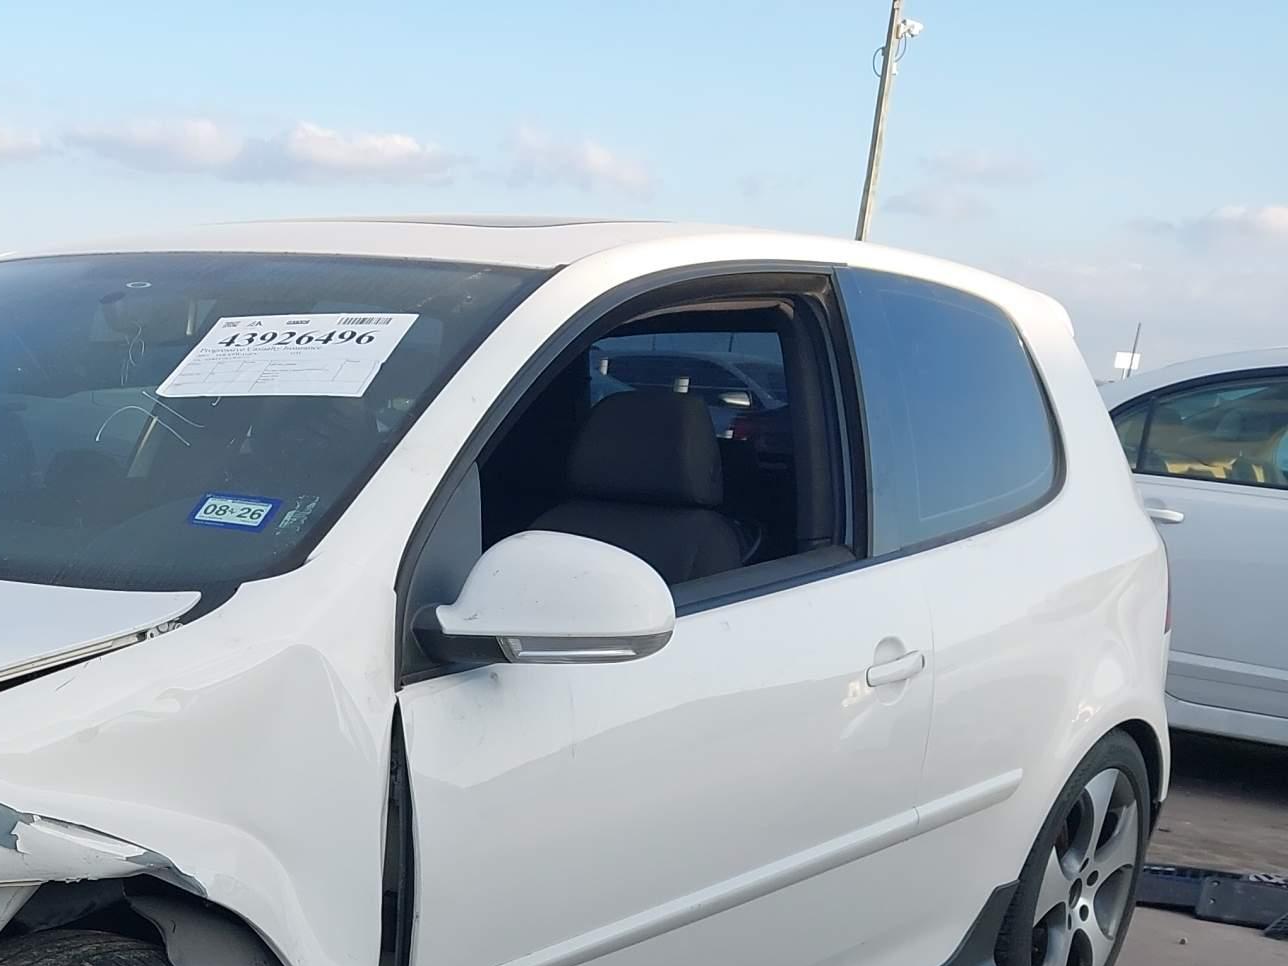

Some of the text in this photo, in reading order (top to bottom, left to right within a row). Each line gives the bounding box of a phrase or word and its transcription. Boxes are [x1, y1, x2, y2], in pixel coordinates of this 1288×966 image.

[218, 330, 379, 347] 43926496
[203, 503, 230, 516] 08
[236, 507, 265, 520] 26
